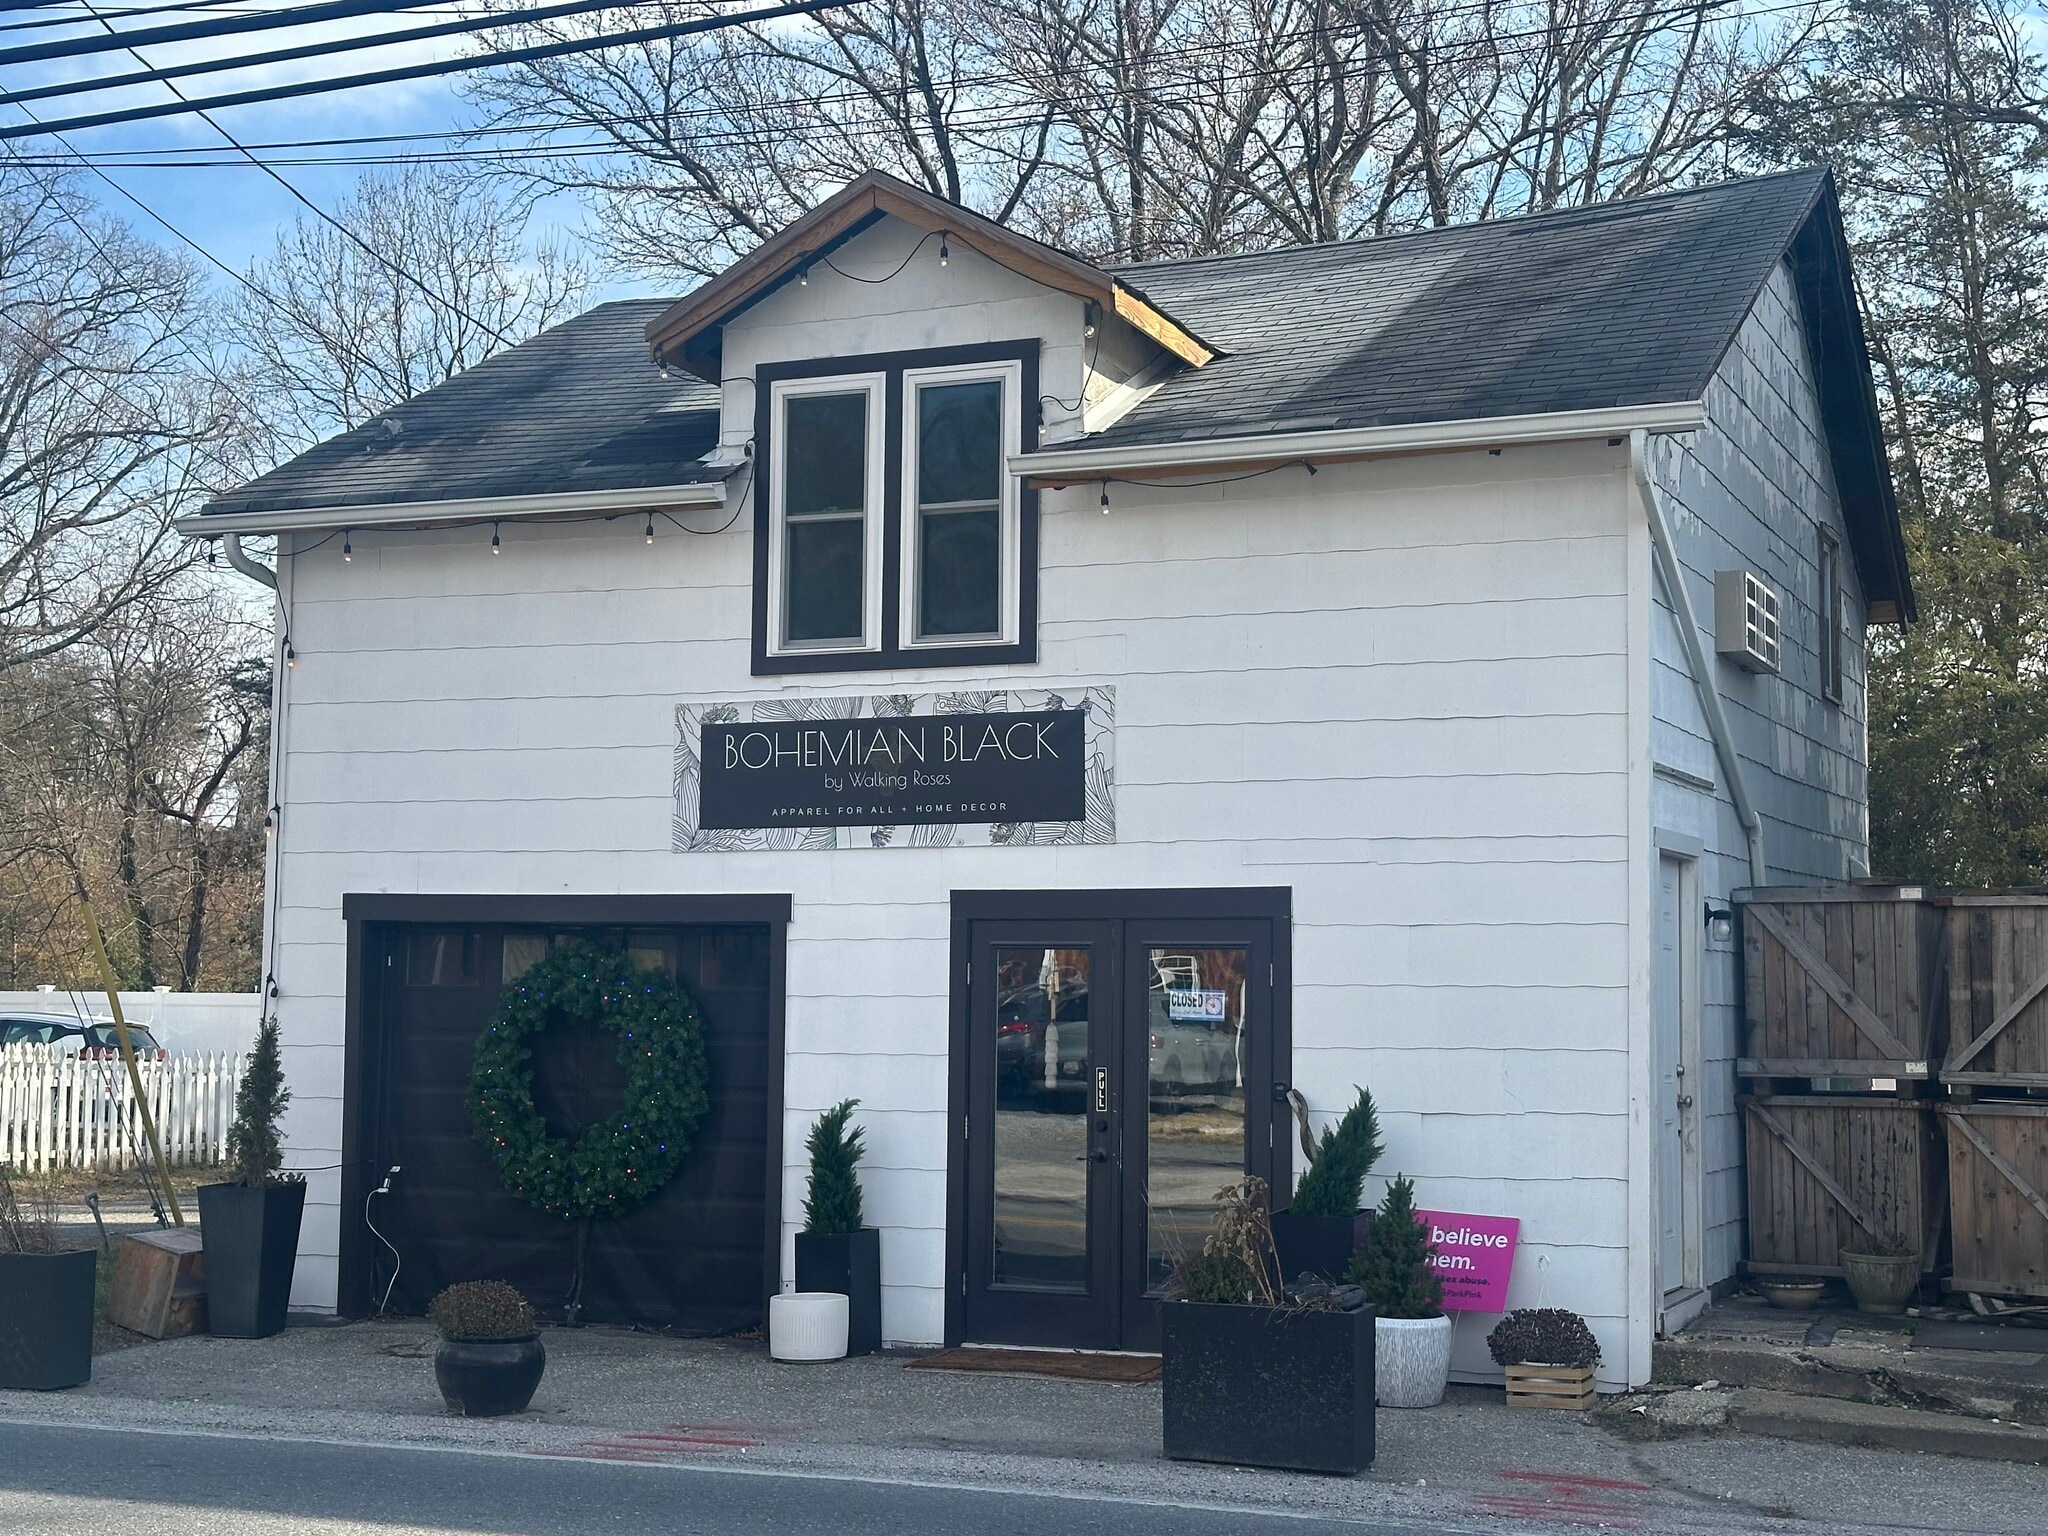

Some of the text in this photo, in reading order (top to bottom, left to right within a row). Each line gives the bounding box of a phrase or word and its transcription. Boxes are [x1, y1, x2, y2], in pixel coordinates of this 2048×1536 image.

[725, 721, 1060, 770] BOHEMIAN BLACK
[824, 769, 951, 792] by Walking Roses
[771, 807, 830, 817] APPAREL
[837, 805, 864, 816] FOR
[870, 804, 894, 814] ALL
[915, 803, 953, 814] HOME
[960, 801, 1008, 812] DECOR
[1171, 992, 1204, 1008] CLOSED
[1431, 1225, 1509, 1249] believe
[1458, 1276, 1490, 1286] abuse.
